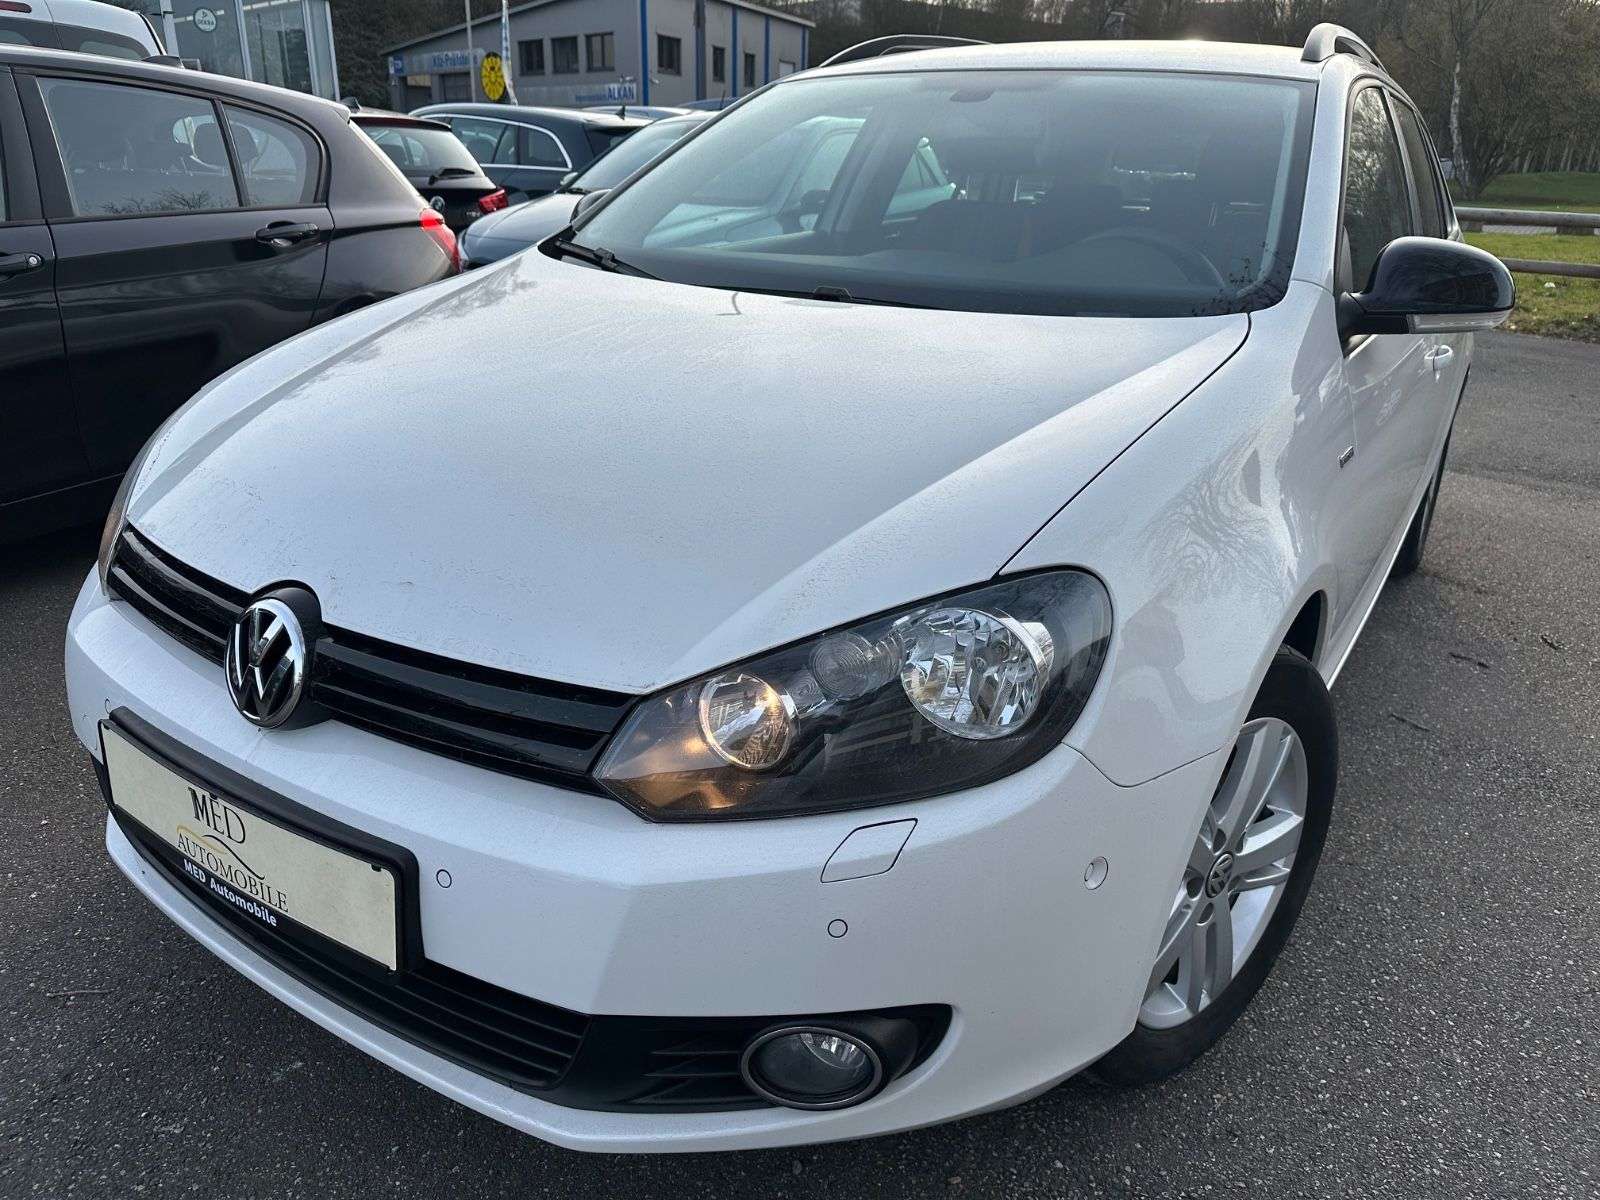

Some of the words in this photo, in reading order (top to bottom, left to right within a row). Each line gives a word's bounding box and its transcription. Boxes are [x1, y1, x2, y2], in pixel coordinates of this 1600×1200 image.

[607, 85, 636, 101] ALKAN
[188, 786, 245, 844] MED
[178, 833, 289, 913] AUTOMOBILE
[184, 859, 206, 883] MED
[210, 877, 277, 927] Automobile
